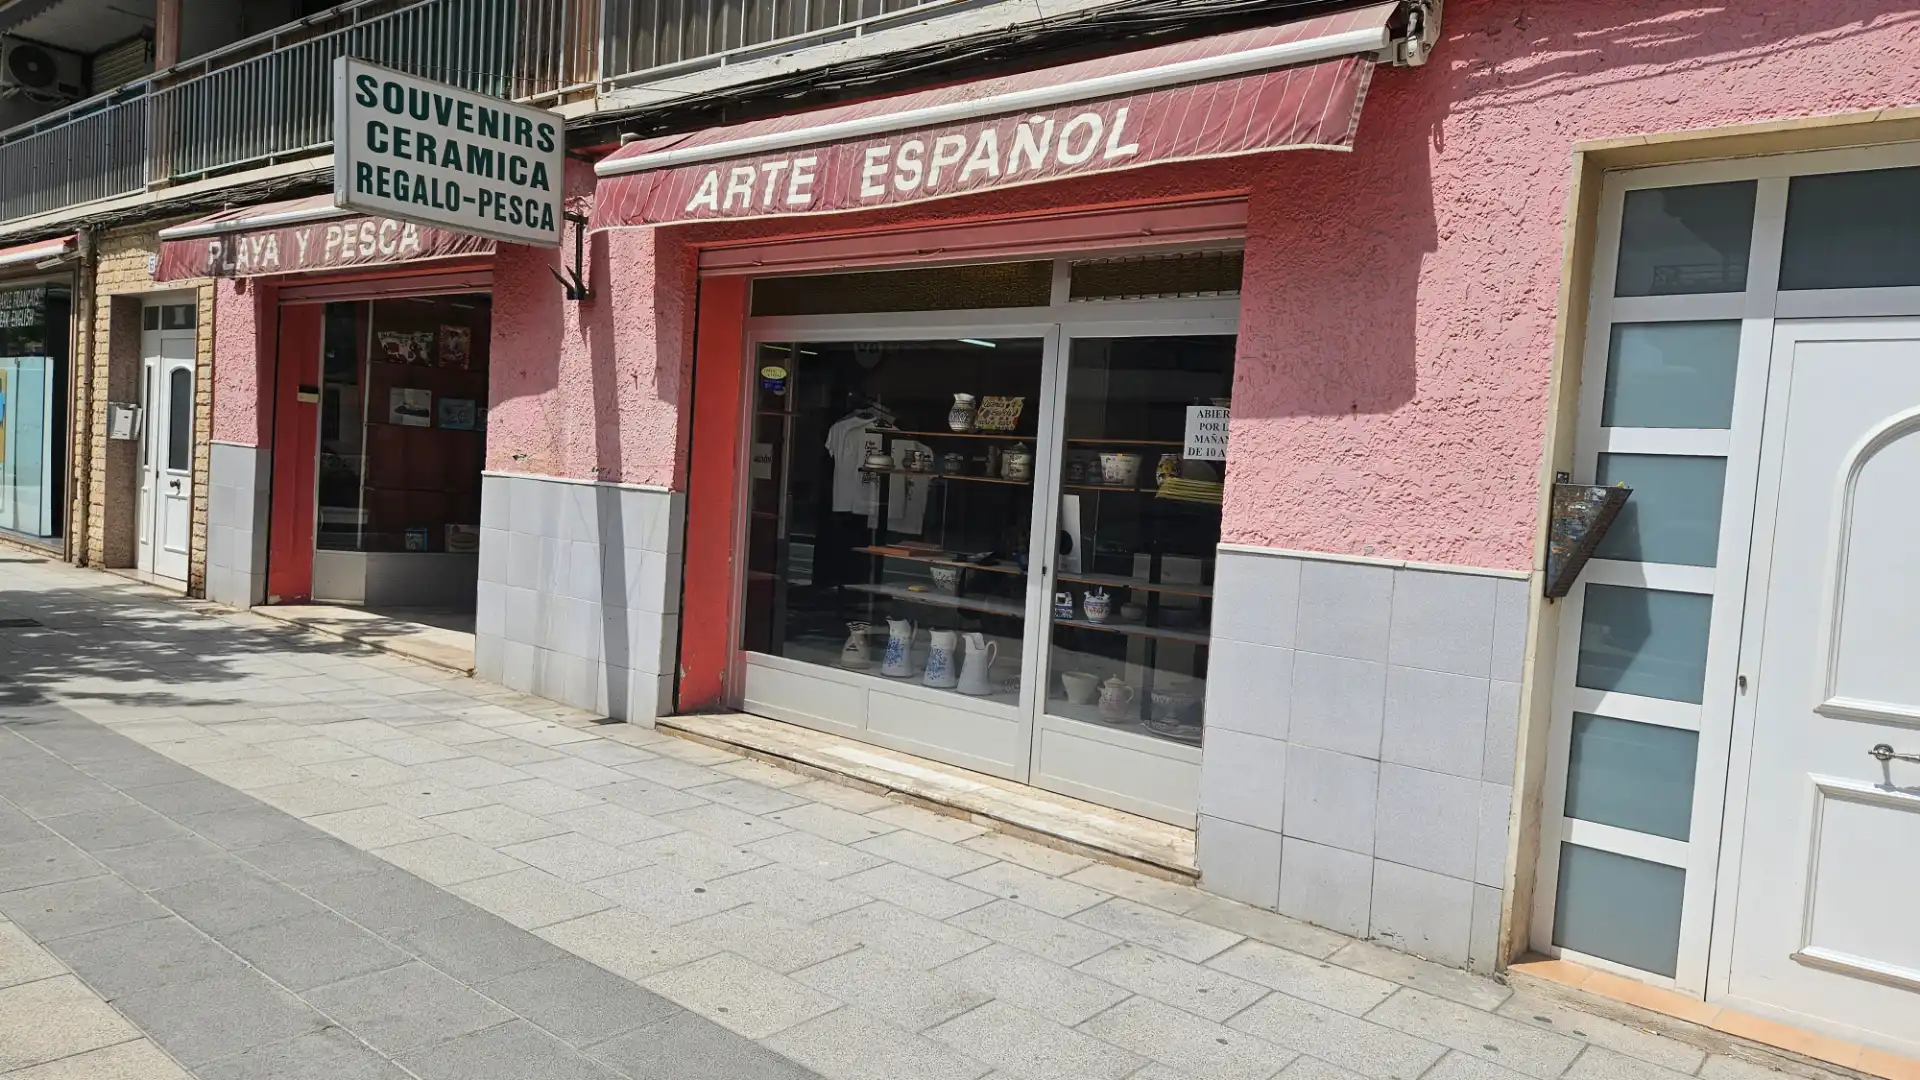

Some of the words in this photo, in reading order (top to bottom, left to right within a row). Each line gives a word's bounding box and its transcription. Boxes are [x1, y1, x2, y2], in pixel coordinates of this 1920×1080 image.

[355, 74, 555, 153] SOUVENIRS
[366, 120, 550, 192] CERAMICA
[685, 155, 818, 212] ARTE
[860, 106, 1141, 198] ESPAÑOL
[356, 160, 555, 232] REGALO-PESCA
[207, 233, 280, 272] PLAYA
[295, 228, 311, 265] Y
[324, 219, 420, 260] PESCA
[1188, 447, 1202, 456] DE
[1207, 448, 1216, 456] 10
[1218, 449, 1226, 457] A
[1200, 423, 1220, 431] POR
